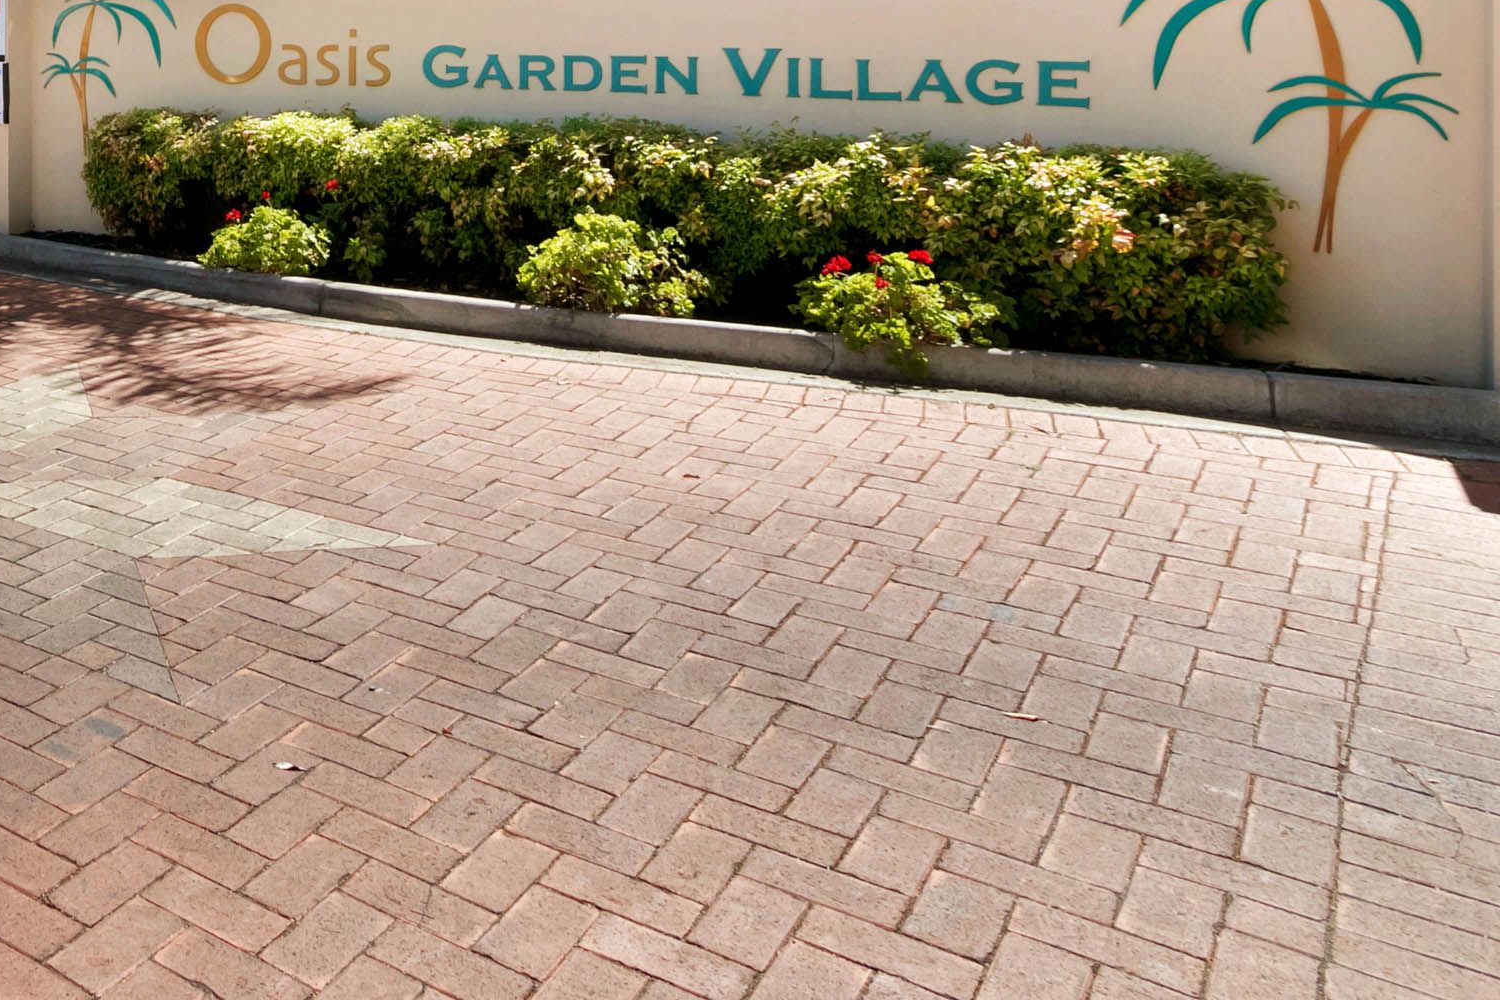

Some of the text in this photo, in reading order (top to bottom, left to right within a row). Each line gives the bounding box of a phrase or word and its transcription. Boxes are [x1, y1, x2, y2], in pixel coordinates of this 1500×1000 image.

[194, 3, 1090, 109] Oasis GARDEN VILLAGE
